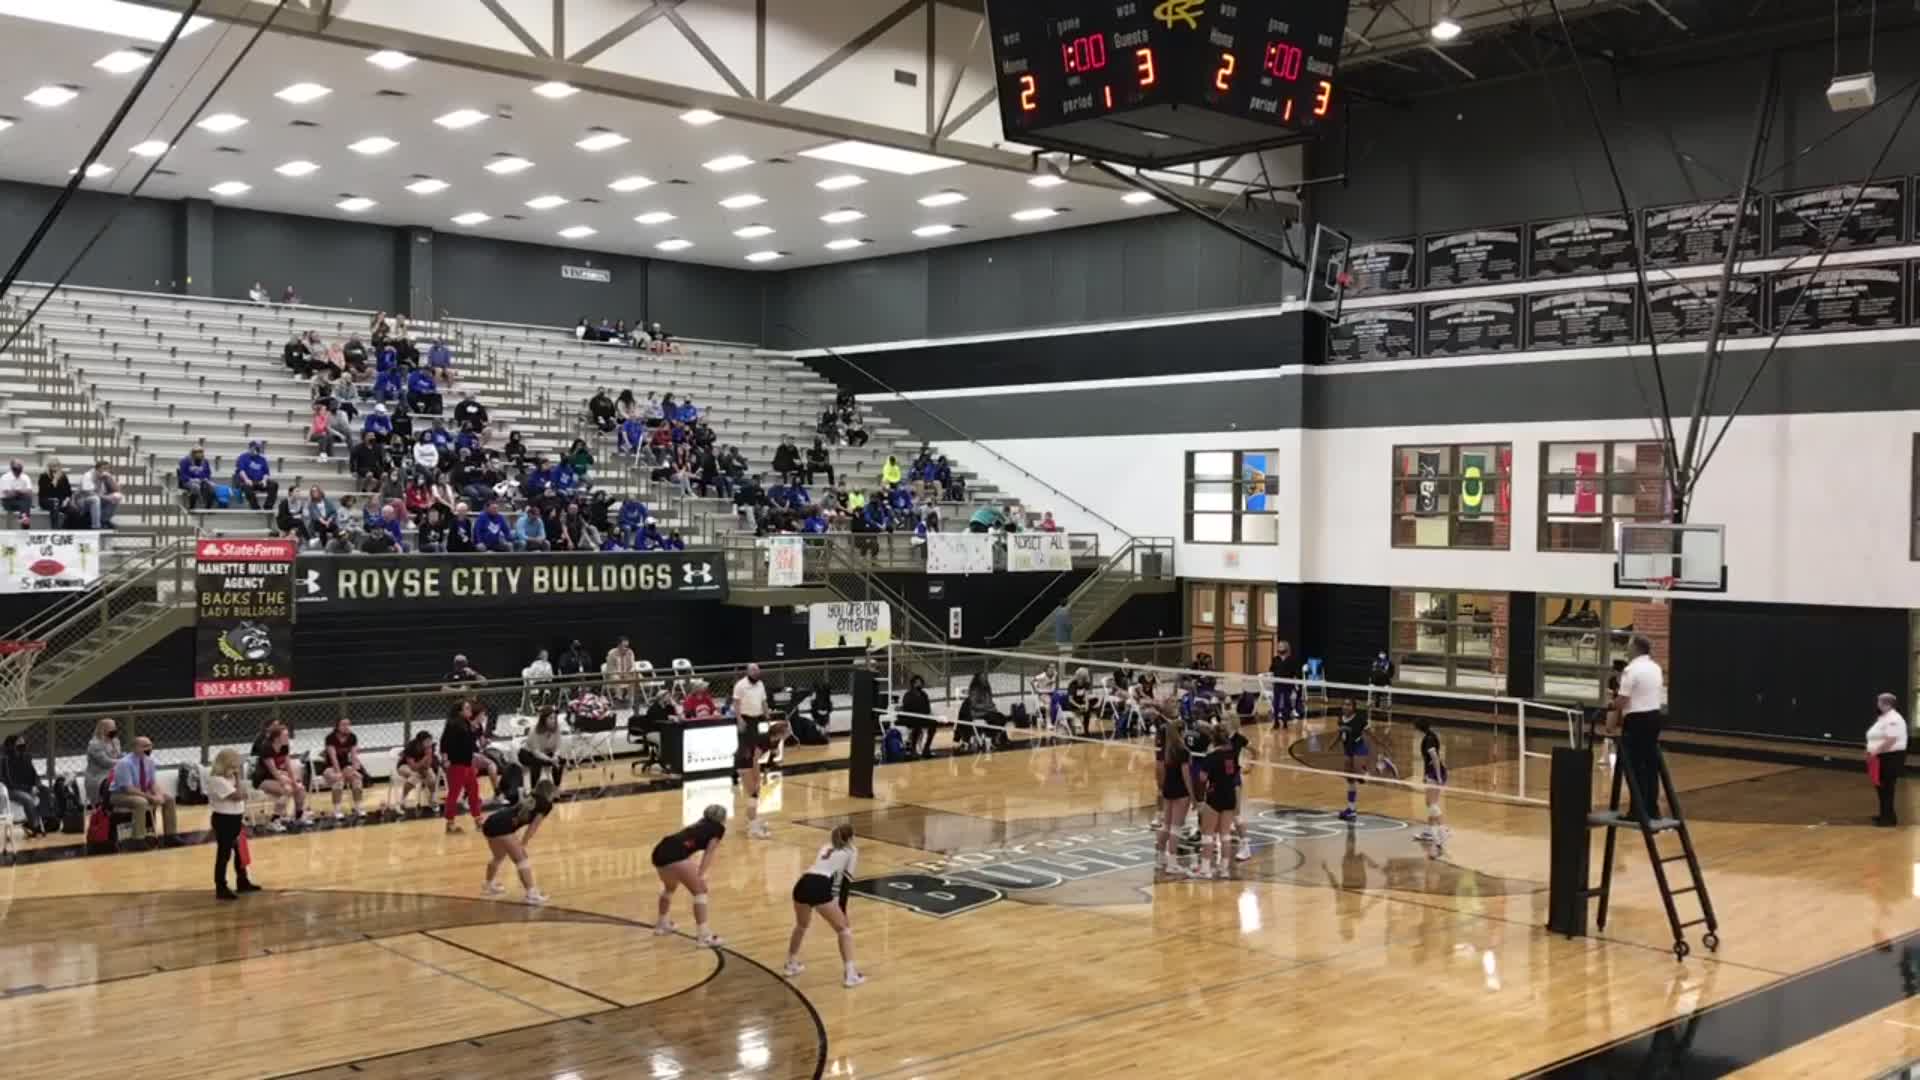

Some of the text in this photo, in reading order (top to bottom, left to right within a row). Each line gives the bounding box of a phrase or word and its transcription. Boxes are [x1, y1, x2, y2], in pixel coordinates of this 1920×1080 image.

[1113, 29, 1150, 49] Guests
[1061, 33, 1106, 73] 1:00
[1135, 48, 1155, 86] 3
[1215, 53, 1236, 91] 2
[1020, 75, 1037, 111] 2
[1104, 85, 1113, 108] 1
[1313, 80, 1332, 116] 3
[1062, 93, 1094, 116] period
[1249, 96, 1279, 113] period
[1283, 99, 1293, 121] 1
[198, 562, 290, 575] NANETTE MULKEY
[223, 577, 265, 589] AGENCY
[337, 563, 673, 599] ROYSE CITY BULLDOGS
[201, 591, 286, 606] BACKS THE
[201, 606, 286, 618] LADY BULLDOGS
[212, 662, 274, 678] $3 for 3's
